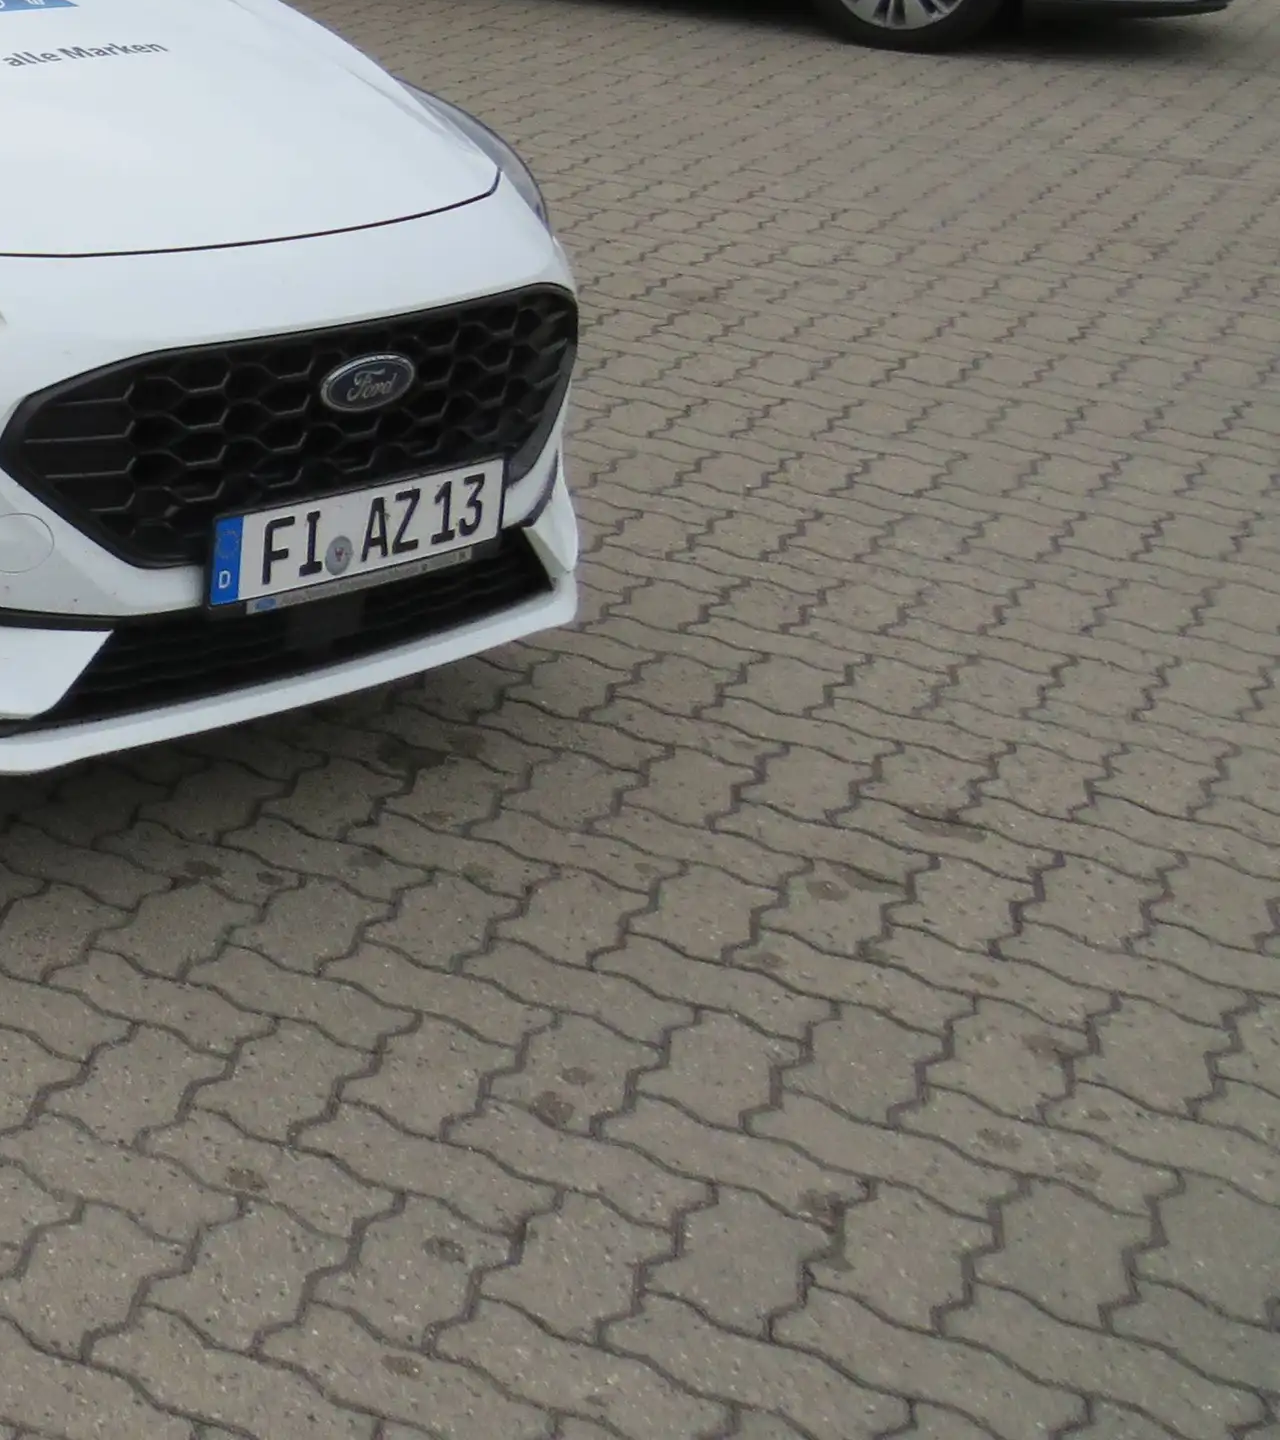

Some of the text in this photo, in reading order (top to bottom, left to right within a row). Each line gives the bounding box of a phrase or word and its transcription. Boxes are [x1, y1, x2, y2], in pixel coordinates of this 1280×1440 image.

[2, 51, 63, 67] alle
[56, 42, 169, 60] Marken
[346, 367, 398, 402] Ford
[218, 570, 231, 589] D
[261, 510, 323, 586] FI
